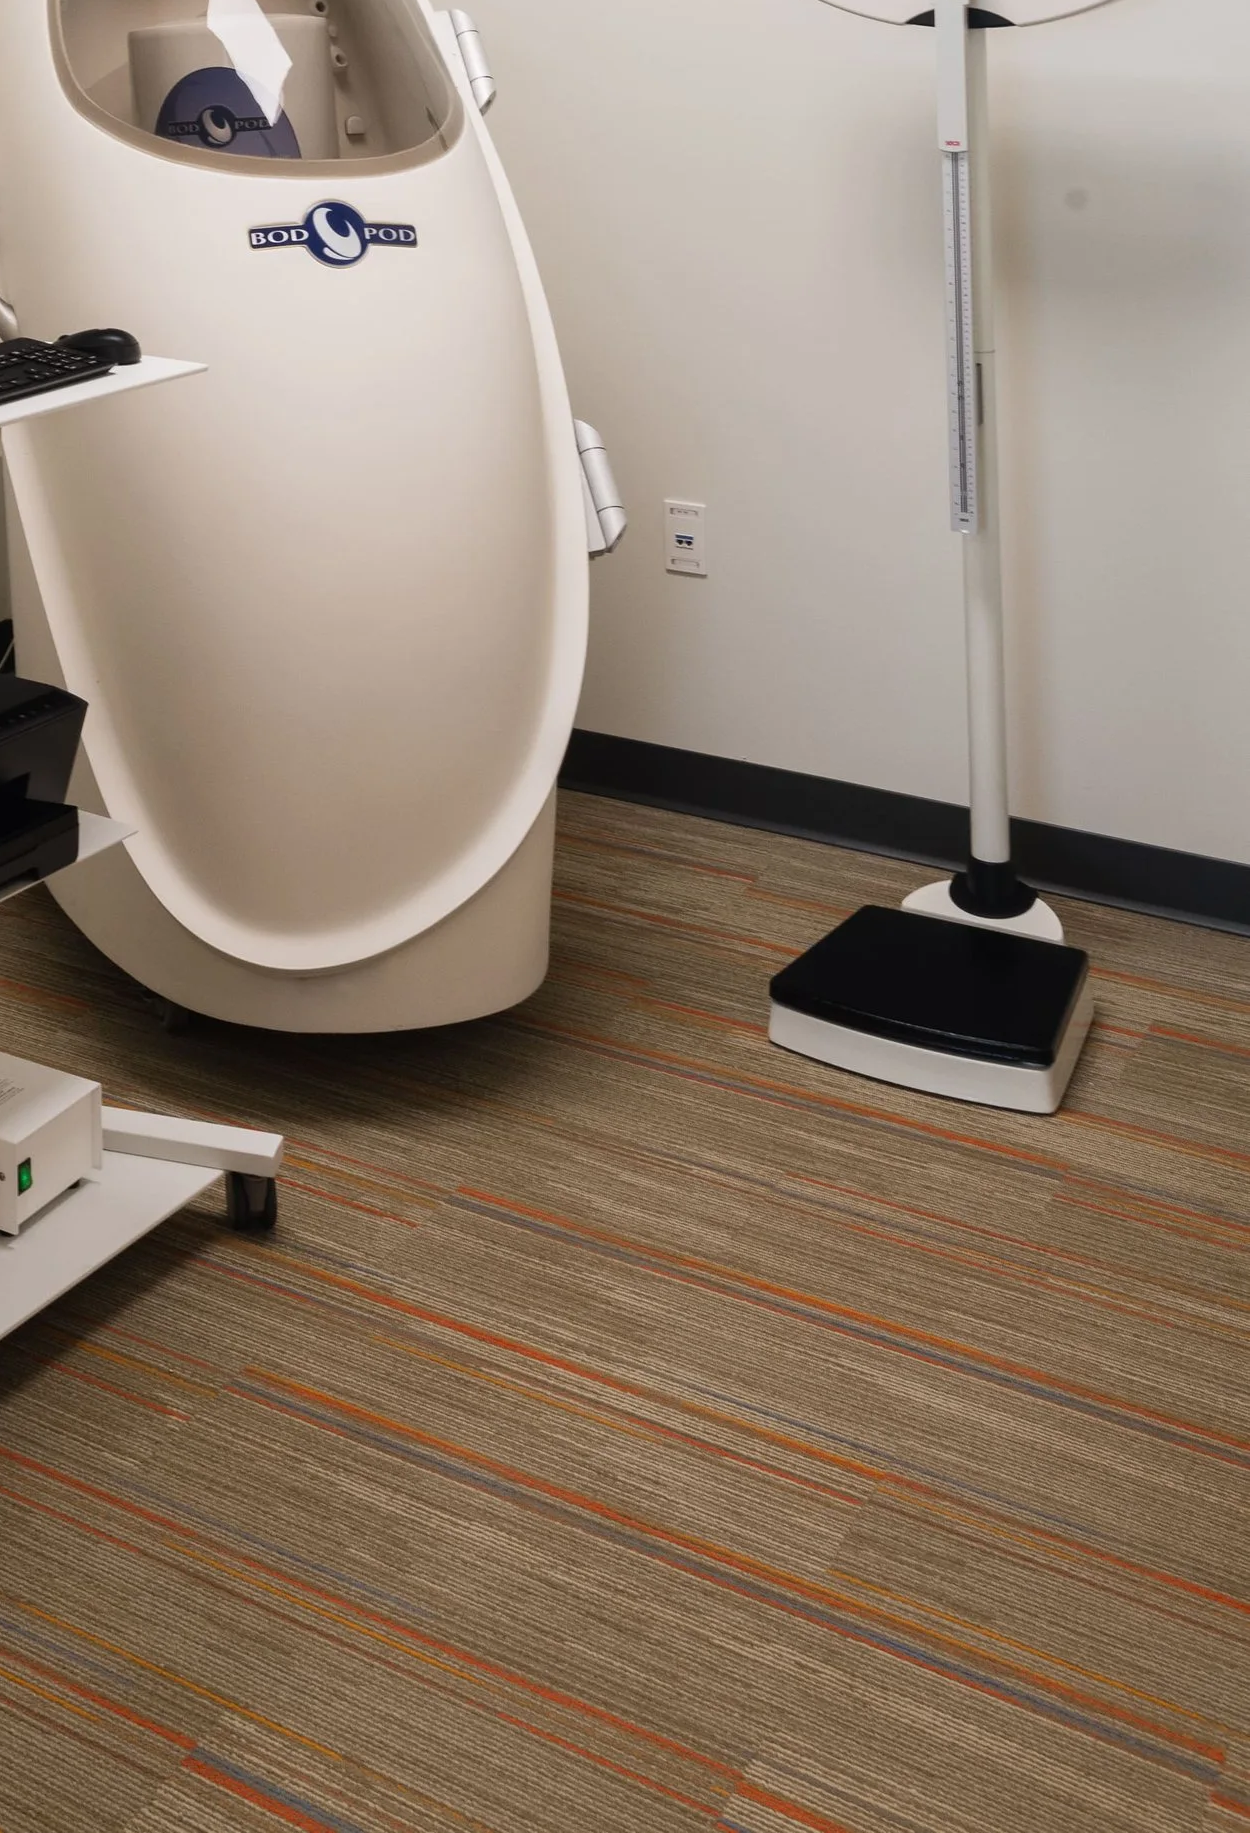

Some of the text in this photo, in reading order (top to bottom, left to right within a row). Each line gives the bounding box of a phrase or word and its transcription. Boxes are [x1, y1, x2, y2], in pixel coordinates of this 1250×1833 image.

[169, 118, 270, 135] BOD POD
[251, 227, 415, 245] BOD POD
